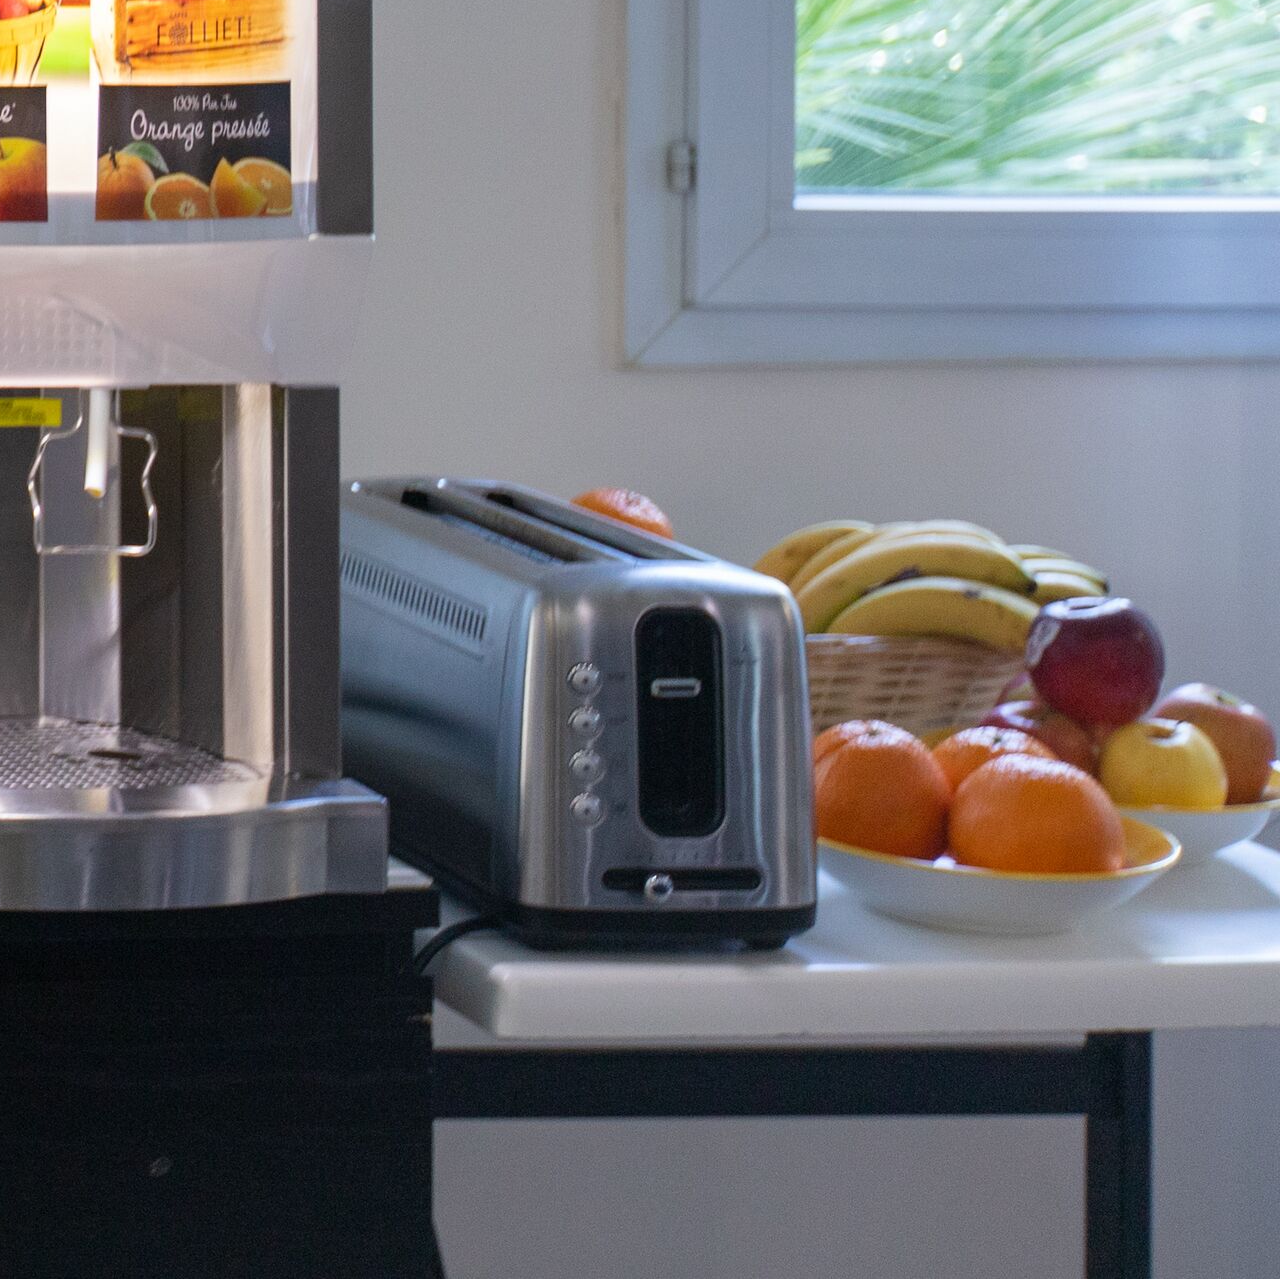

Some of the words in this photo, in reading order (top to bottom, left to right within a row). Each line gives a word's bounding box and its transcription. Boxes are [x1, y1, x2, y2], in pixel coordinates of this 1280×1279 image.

[173, 94, 200, 112] 100%
[220, 93, 237, 111] Jus
[130, 108, 204, 152] Orange
[211, 112, 271, 146] pressée
